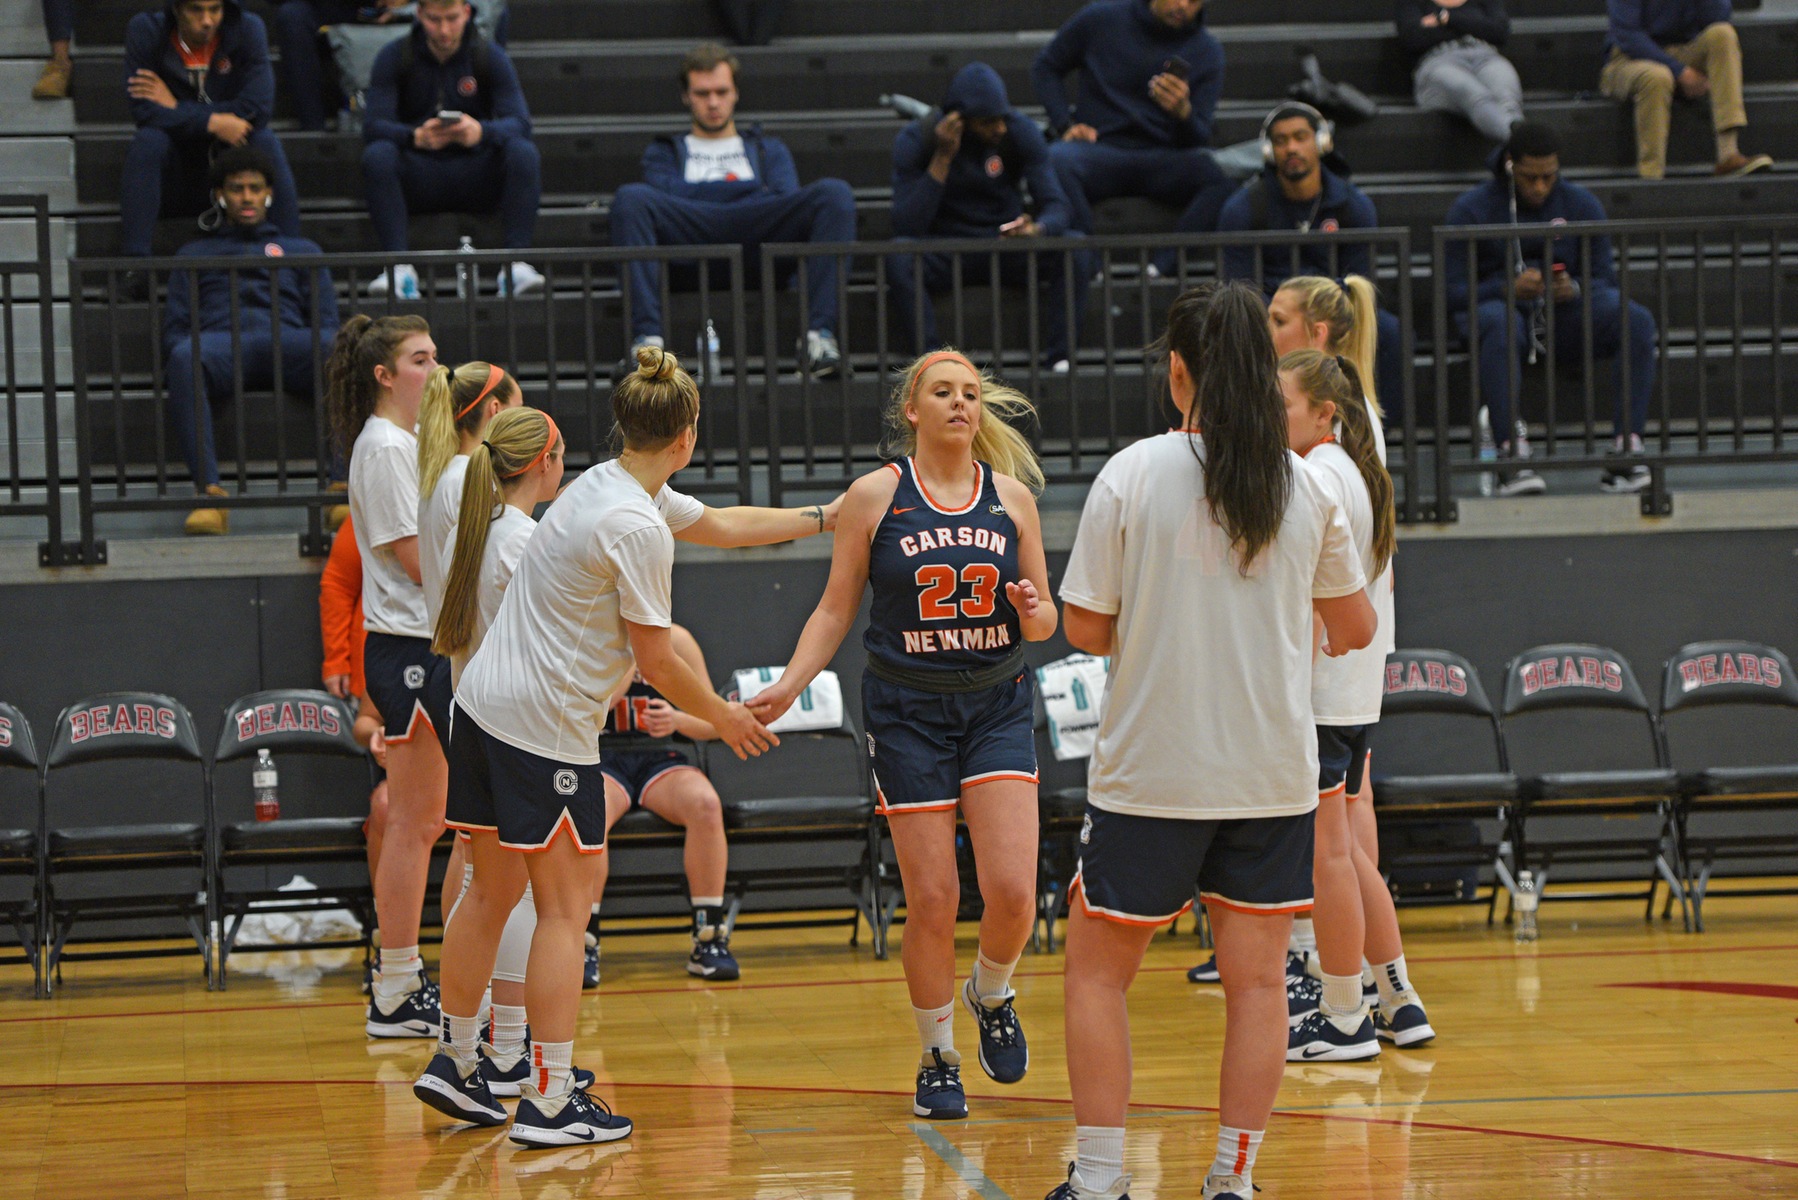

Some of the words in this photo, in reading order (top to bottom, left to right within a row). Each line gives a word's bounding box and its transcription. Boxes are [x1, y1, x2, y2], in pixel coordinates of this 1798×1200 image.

[900, 527, 1006, 557] CARSON
[915, 563, 1000, 621] 23
[902, 624, 1011, 653] NEWMAN
[1383, 661, 1467, 697] EARS
[1519, 656, 1622, 696] BEARS
[1678, 653, 1781, 693] BEARS
[69, 704, 176, 744] BEARS
[235, 701, 340, 742] BEARS
